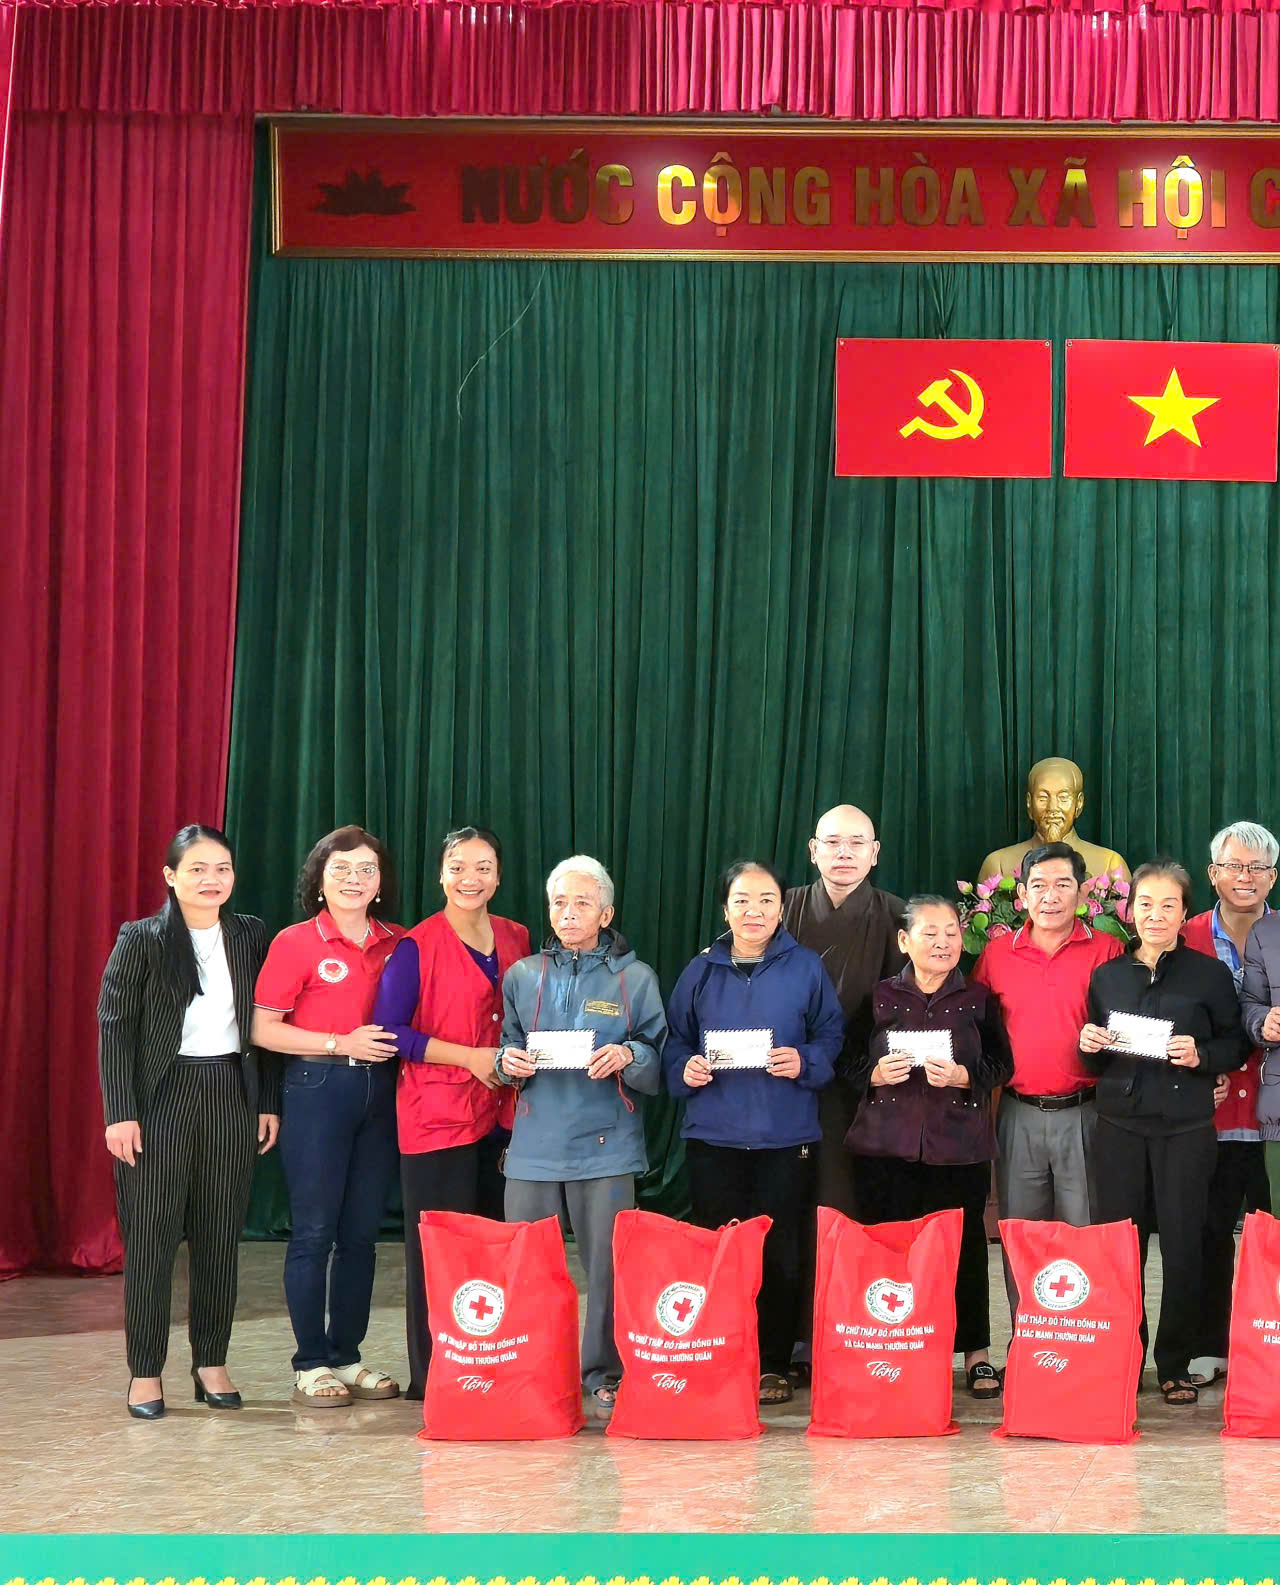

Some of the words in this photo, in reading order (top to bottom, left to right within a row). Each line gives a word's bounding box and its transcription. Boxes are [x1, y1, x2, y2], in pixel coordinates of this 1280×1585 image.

[459, 148, 635, 225] NƯỚC
[657, 151, 832, 237] CỘNG
[853, 151, 986, 227] HÒA
[1007, 156, 1097, 228] XÃ
[1117, 154, 1227, 239] HỘI
[866, 1361, 901, 1383] Tặng
[1033, 1351, 1069, 1373] Tặng
[457, 1376, 494, 1393] Tặng
[652, 1373, 687, 1394] Tặng
